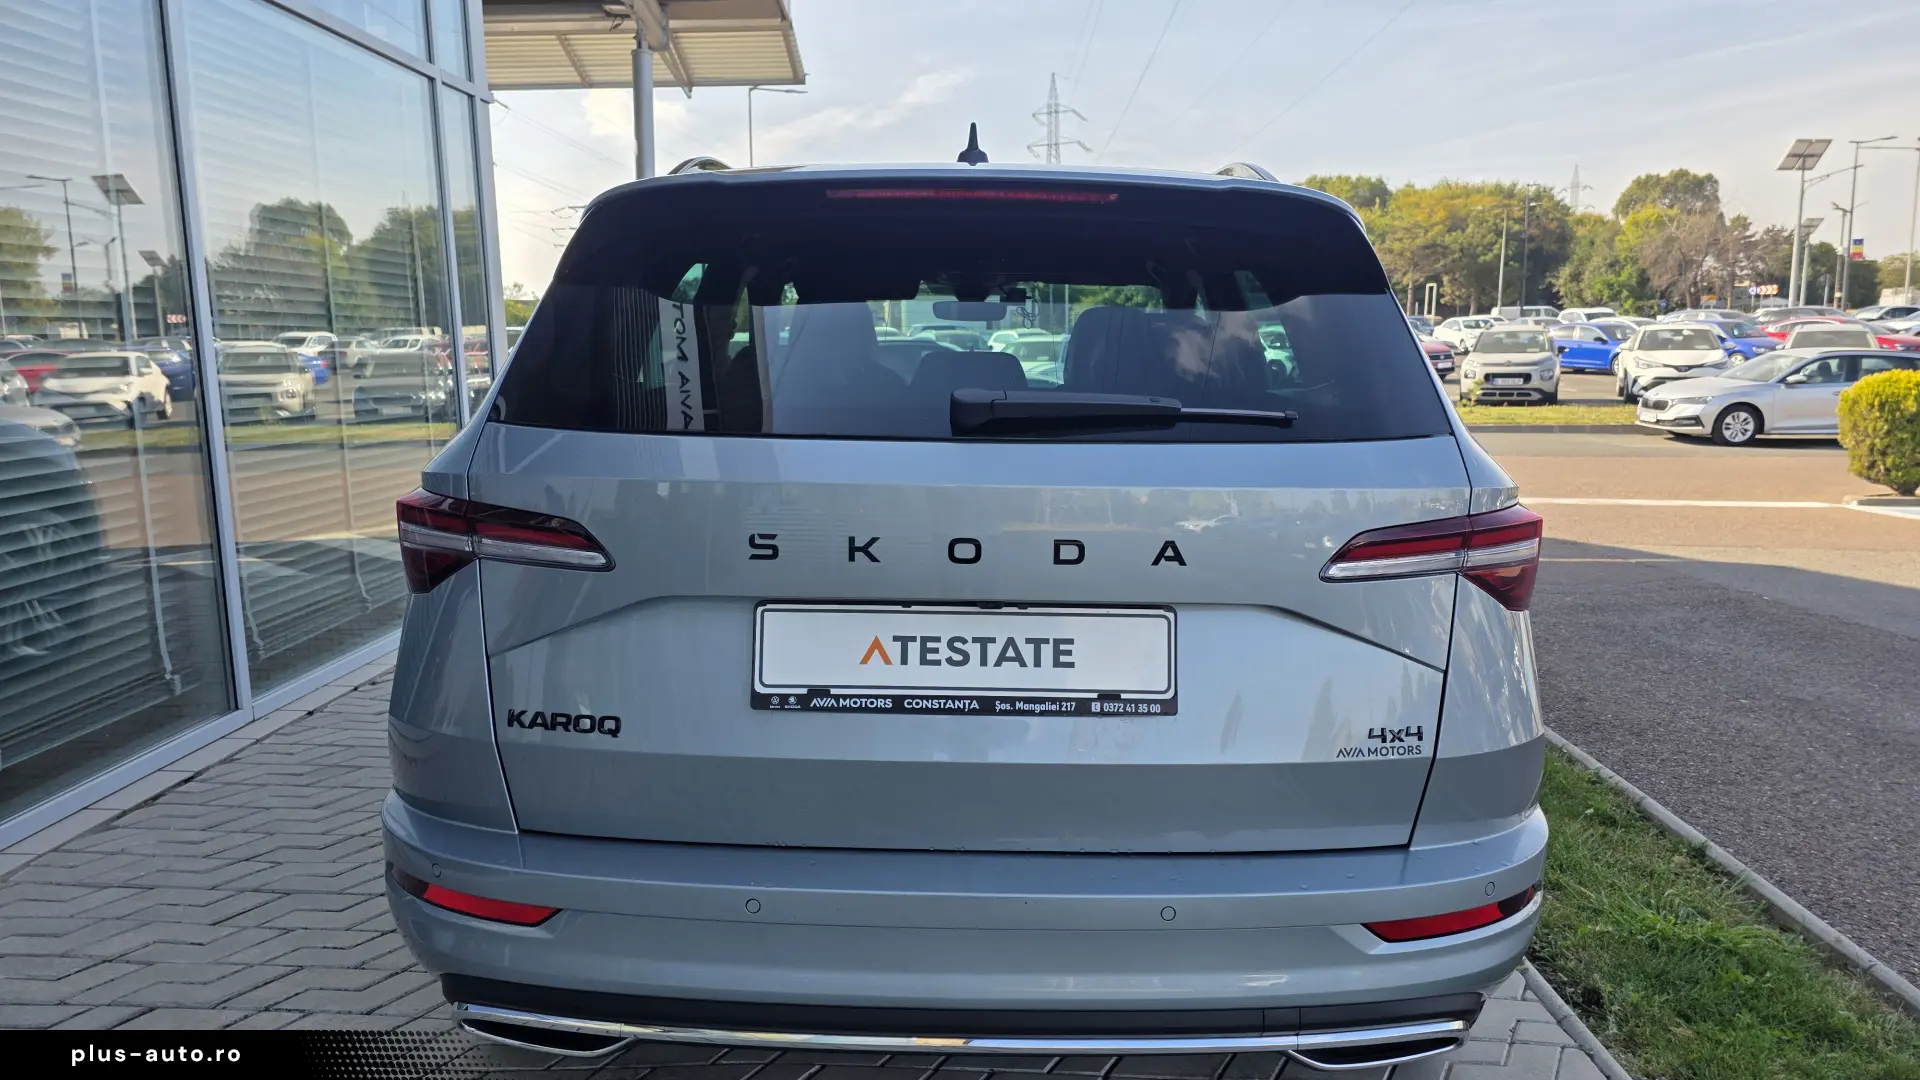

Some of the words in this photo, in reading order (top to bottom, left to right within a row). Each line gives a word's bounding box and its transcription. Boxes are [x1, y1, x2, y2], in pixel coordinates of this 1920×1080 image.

[858, 634, 1076, 669] ATESTATE
[839, 698, 893, 708] MOTORS
[903, 699, 980, 712] CONSTANȚA
[1015, 701, 1060, 713] Mangaliei
[1061, 702, 1076, 711] 217
[1103, 702, 1124, 713] 0372
[1125, 703, 1136, 713] 41
[1137, 703, 1149, 713] 35
[1149, 704, 1161, 713] 00
[507, 708, 622, 738] KAROQ
[1367, 725, 1424, 744] 4x4
[1367, 744, 1422, 758] MOTORS
